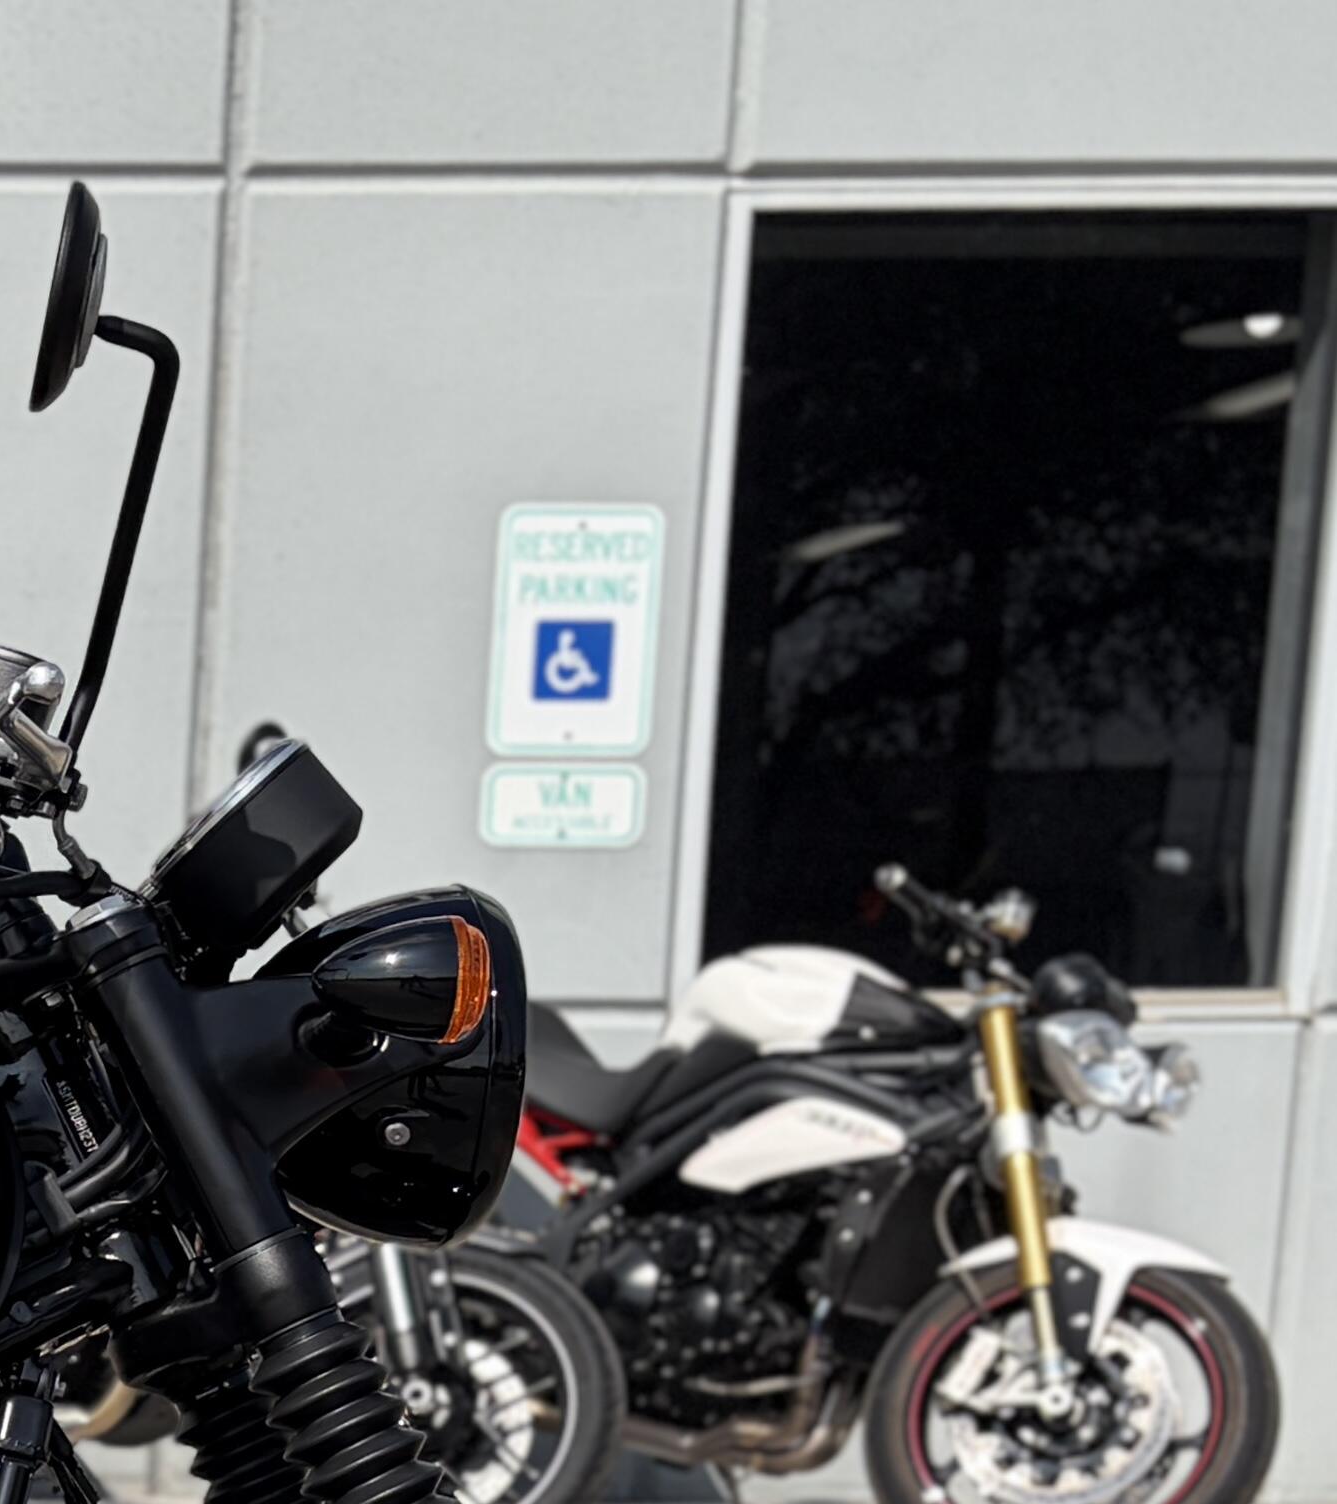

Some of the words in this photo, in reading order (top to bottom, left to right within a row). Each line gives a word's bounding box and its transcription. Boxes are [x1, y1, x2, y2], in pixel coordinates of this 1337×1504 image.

[514, 531, 650, 563] RESERVED
[518, 573, 639, 605] PARKING
[537, 781, 593, 808] VAN
